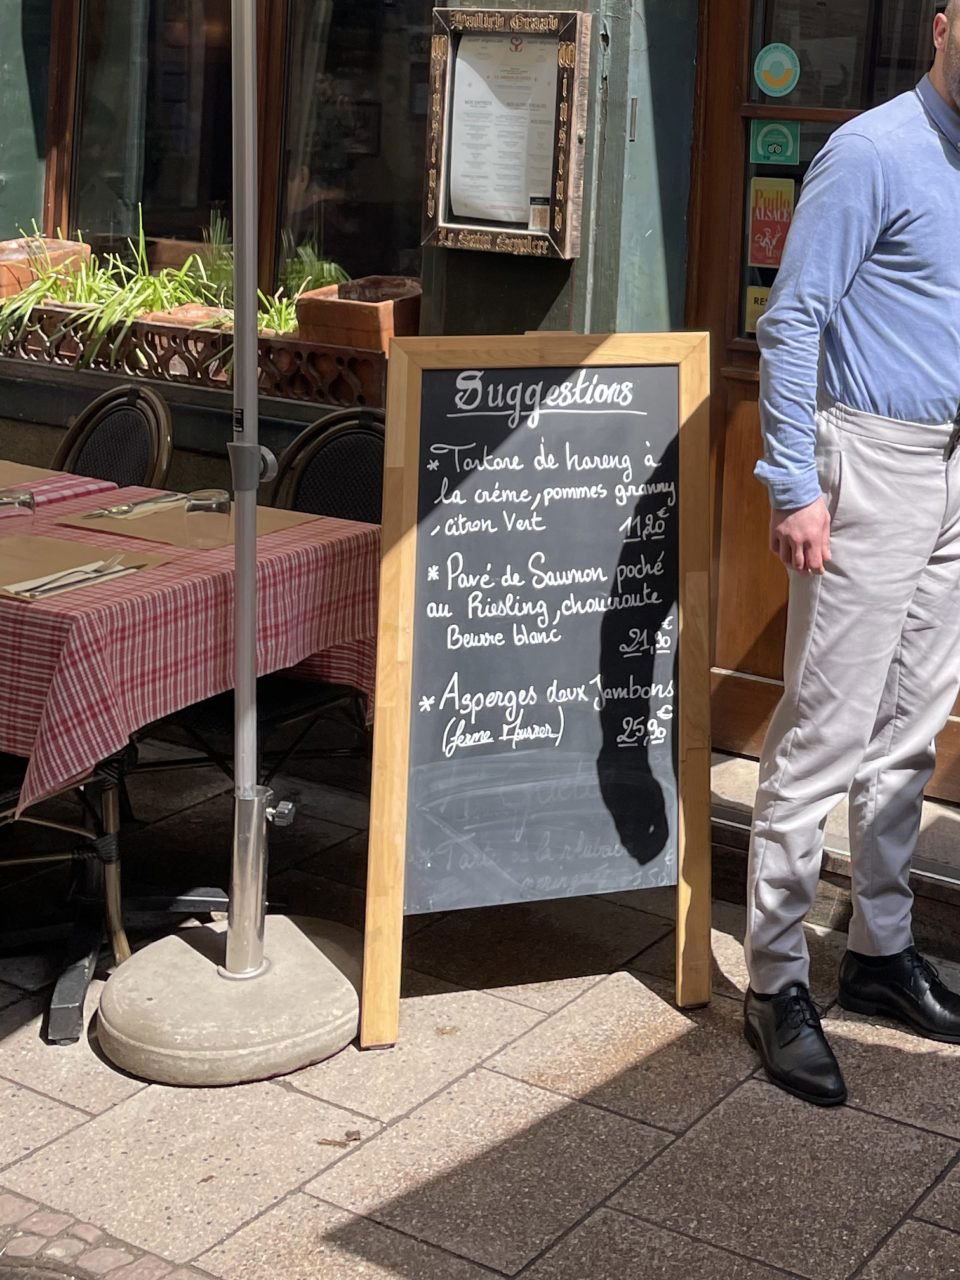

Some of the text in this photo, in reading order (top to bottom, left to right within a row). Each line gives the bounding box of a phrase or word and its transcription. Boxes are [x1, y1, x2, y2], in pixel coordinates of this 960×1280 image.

[753, 207, 792, 222] ALSACE
[455, 369, 634, 428] Suggestions
[534, 436, 559, 470] de
[566, 441, 632, 482] hareng
[645, 440, 662, 467] à
[434, 477, 467, 504] la
[543, 483, 607, 506] pommes
[503, 510, 546, 531] Vert
[447, 551, 664, 593] Pavé de Saumon poché
[427, 602, 453, 617] au
[447, 623, 561, 649] Beurre blanc
[439, 671, 537, 724] Asperges
[547, 679, 589, 702] deux
